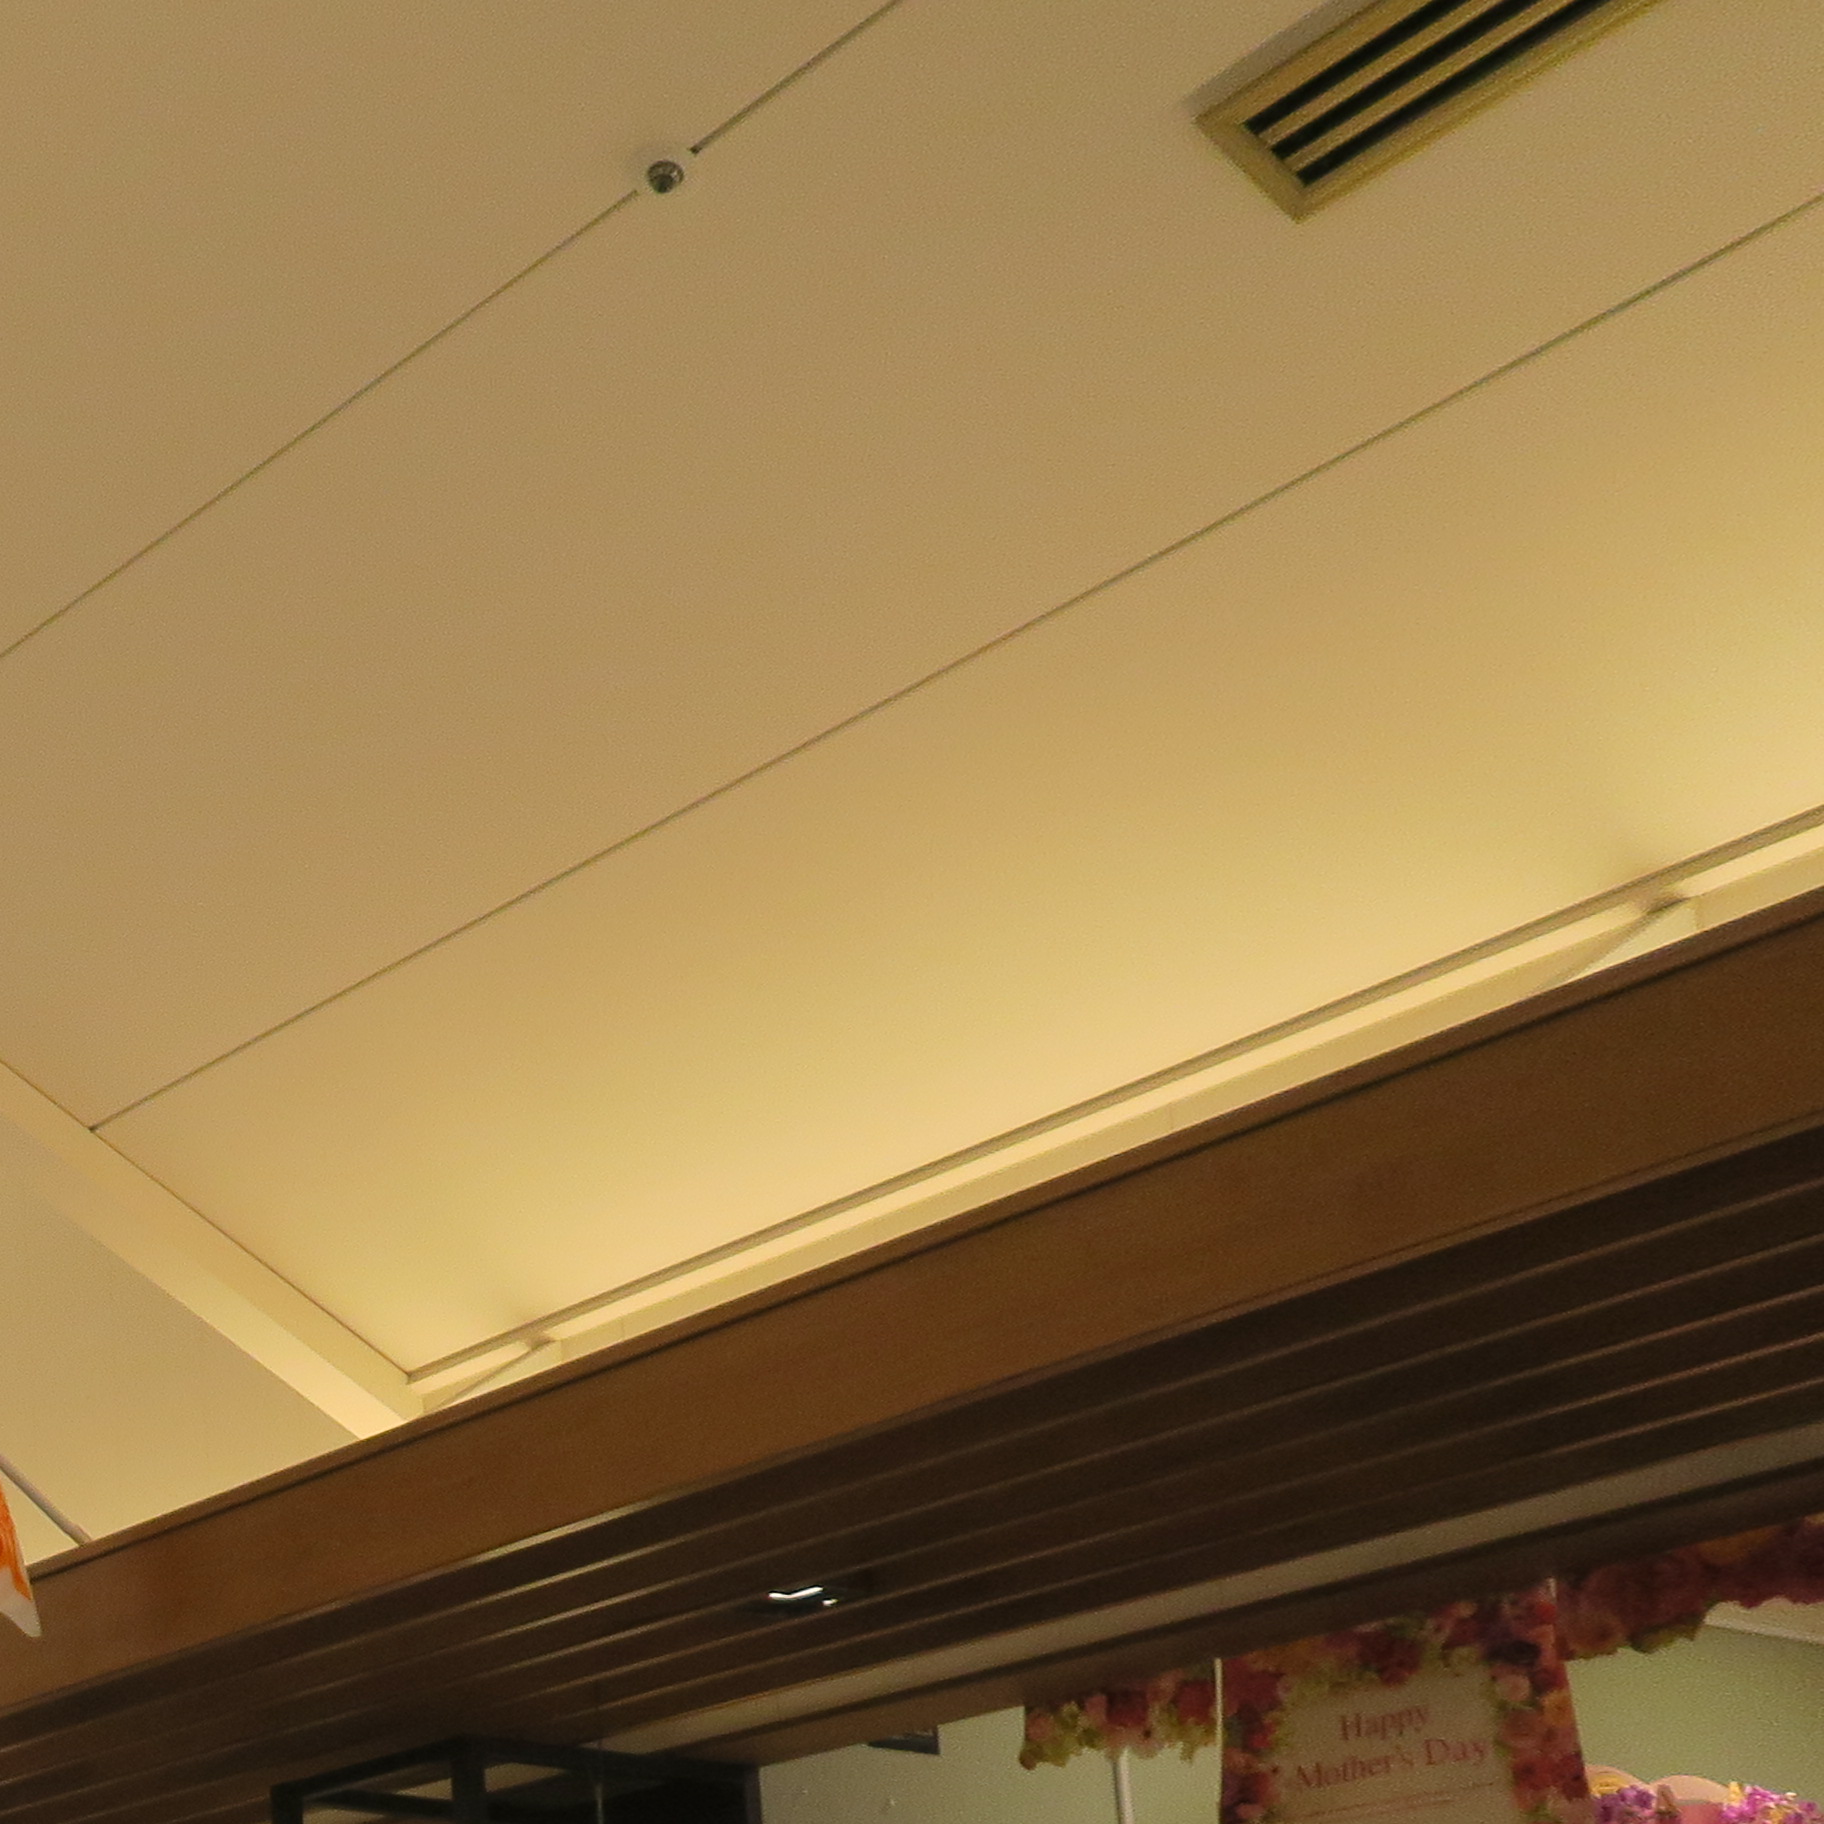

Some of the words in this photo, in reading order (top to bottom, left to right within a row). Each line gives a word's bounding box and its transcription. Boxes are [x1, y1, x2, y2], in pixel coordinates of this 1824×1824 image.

[1339, 1704, 1430, 1741] Happy
[1296, 1744, 1415, 1788] Mother's
[1423, 1738, 1488, 1767] Day
